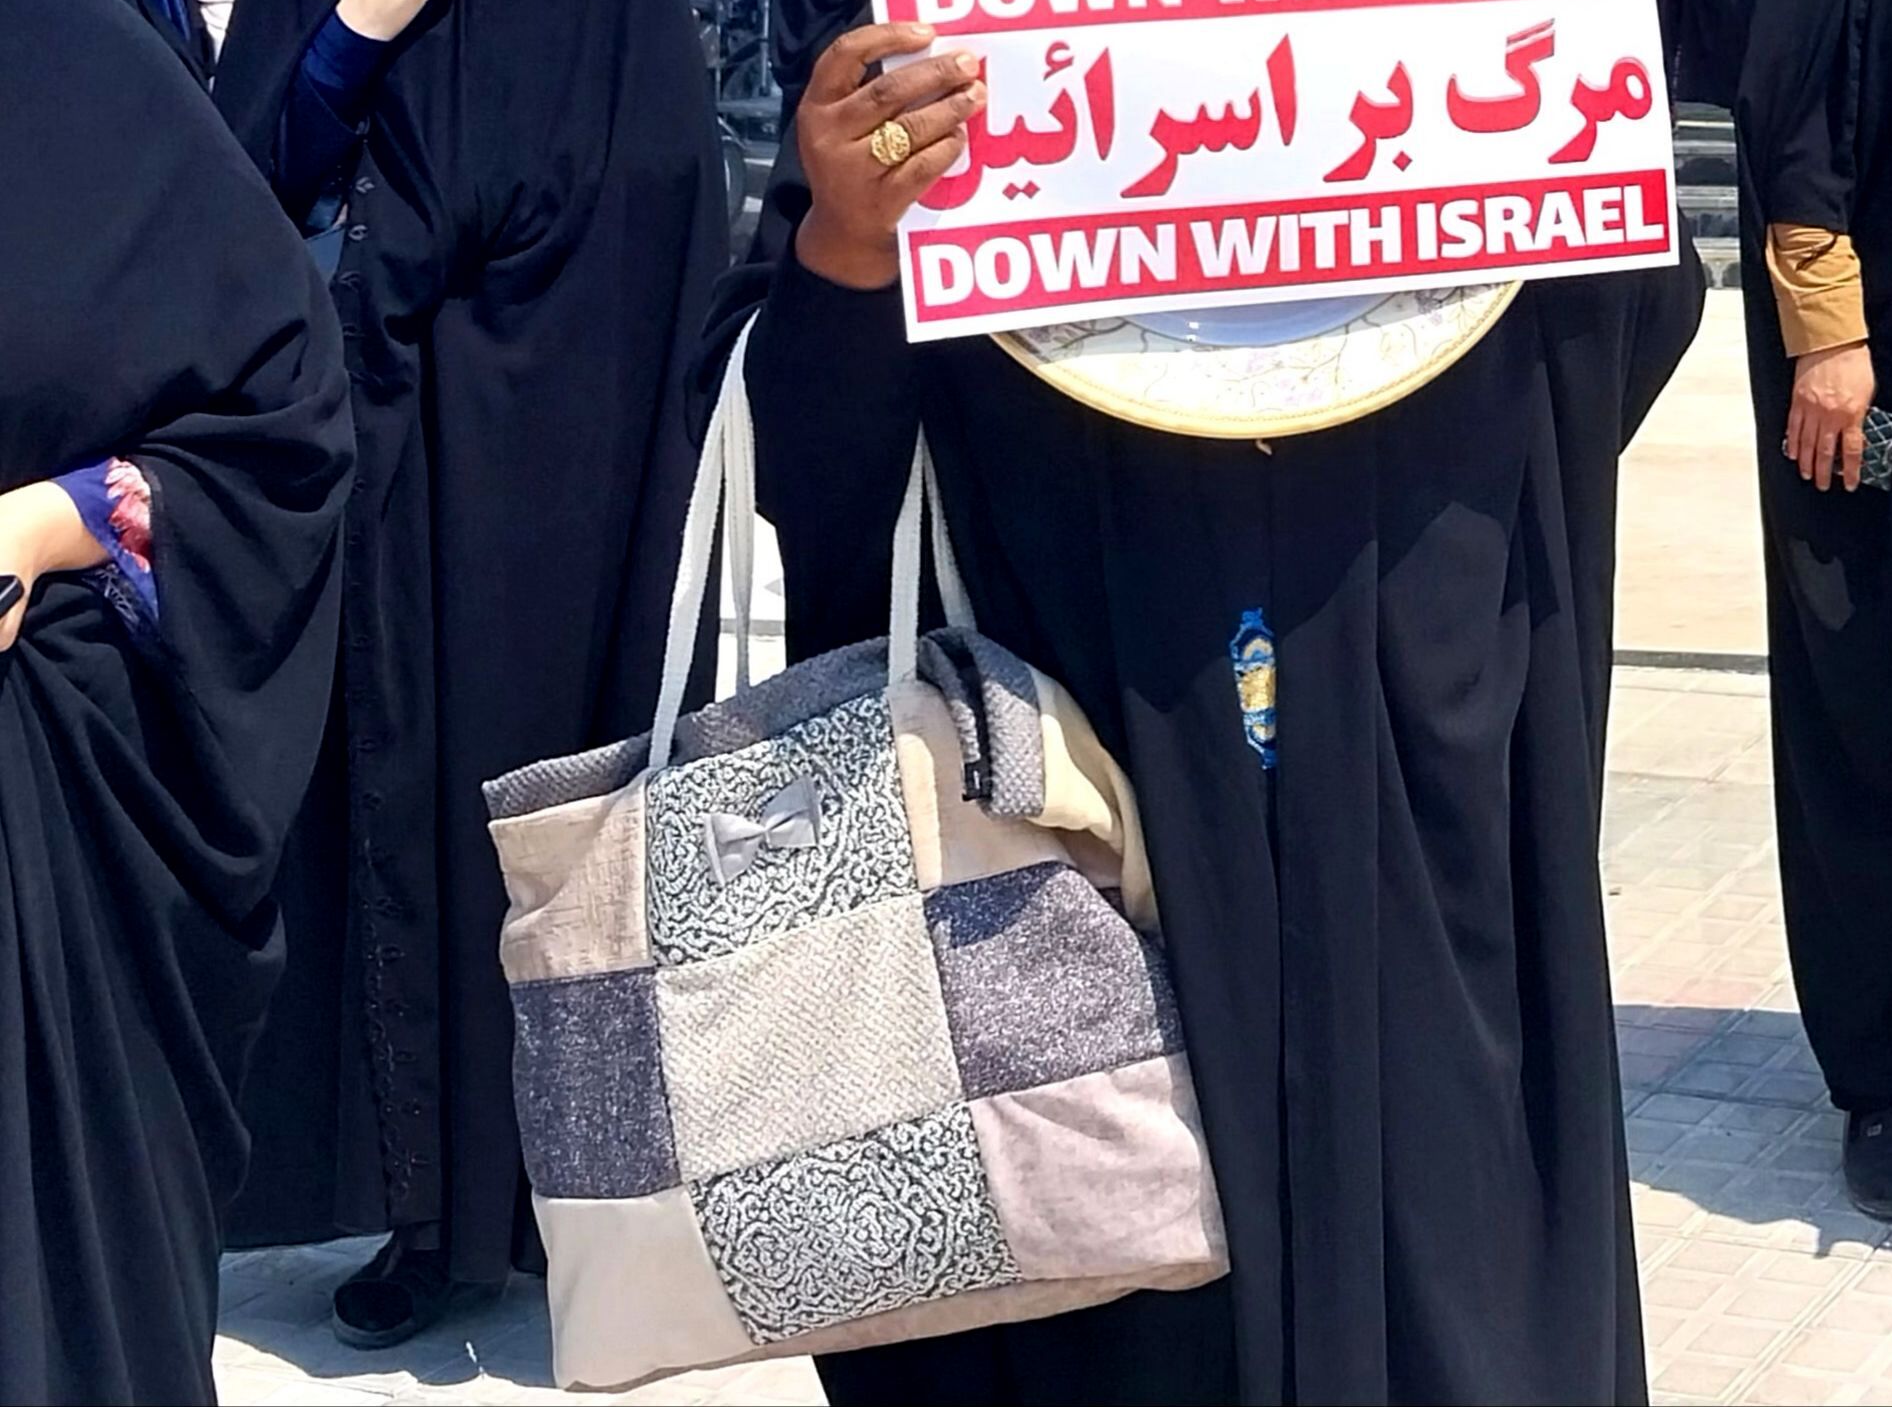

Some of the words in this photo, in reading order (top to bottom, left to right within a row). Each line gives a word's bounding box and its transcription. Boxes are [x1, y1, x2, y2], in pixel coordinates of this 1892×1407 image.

[1323, 61, 1414, 183] بر
[1447, 19, 1653, 165] مرگ
[919, 222, 1177, 307] DOWN
[1190, 204, 1402, 280] WITH
[1416, 184, 1665, 260] ISRAEL
